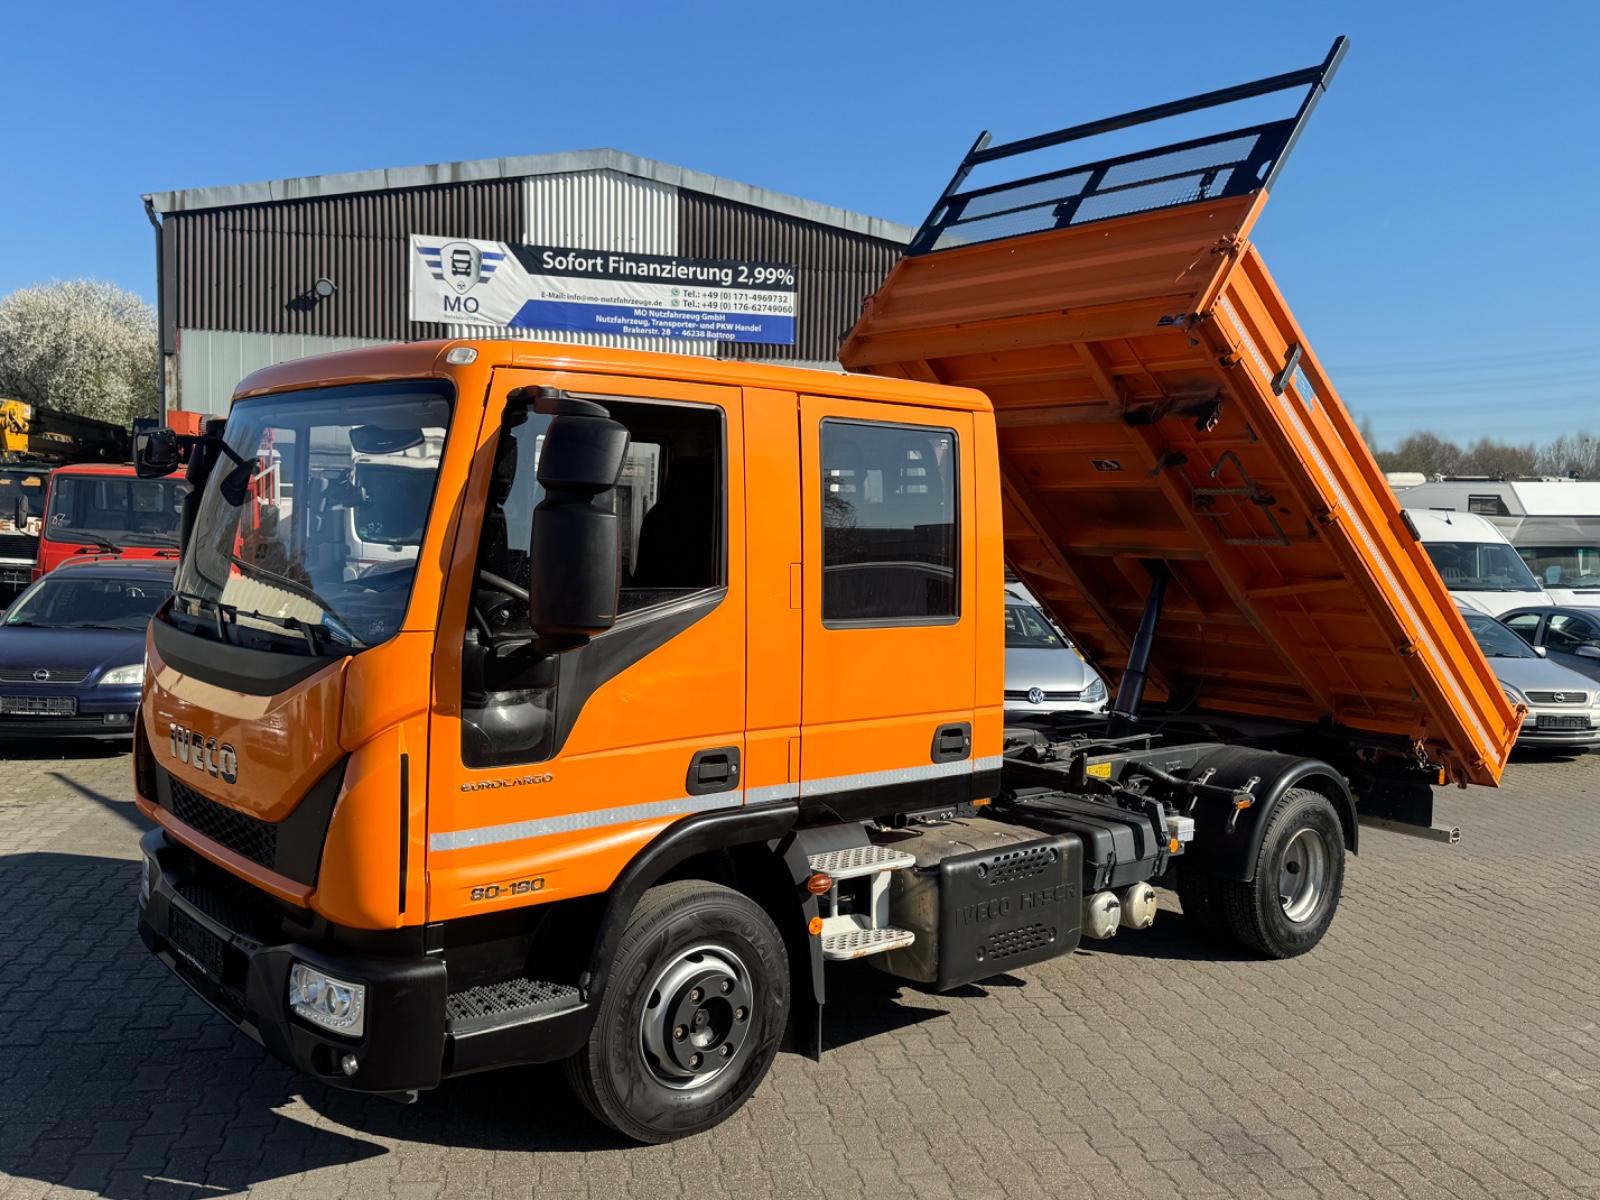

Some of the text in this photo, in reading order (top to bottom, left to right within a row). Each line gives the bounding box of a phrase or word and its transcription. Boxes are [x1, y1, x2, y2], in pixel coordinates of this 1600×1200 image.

[542, 251, 794, 286] Sofort Finanzierung 2,99%
[444, 295, 480, 314] MO
[683, 289, 788, 303] Tel.: +49 (0) 171-4969732
[634, 308, 726, 321] MO Nutzfahrzeug GmbH
[683, 299, 793, 314] Tel.: +49 (0) 176-62749060
[595, 315, 762, 332] Nutzfahrzeug, Transporter- und PKW Handel
[623, 325, 660, 335] Brakerstr.
[682, 329, 706, 337] 46238
[706, 331, 736, 340] Bottrop
[169, 722, 239, 785] IVECO
[460, 773, 553, 792] EUROCARGO
[955, 896, 1010, 928] IVECO
